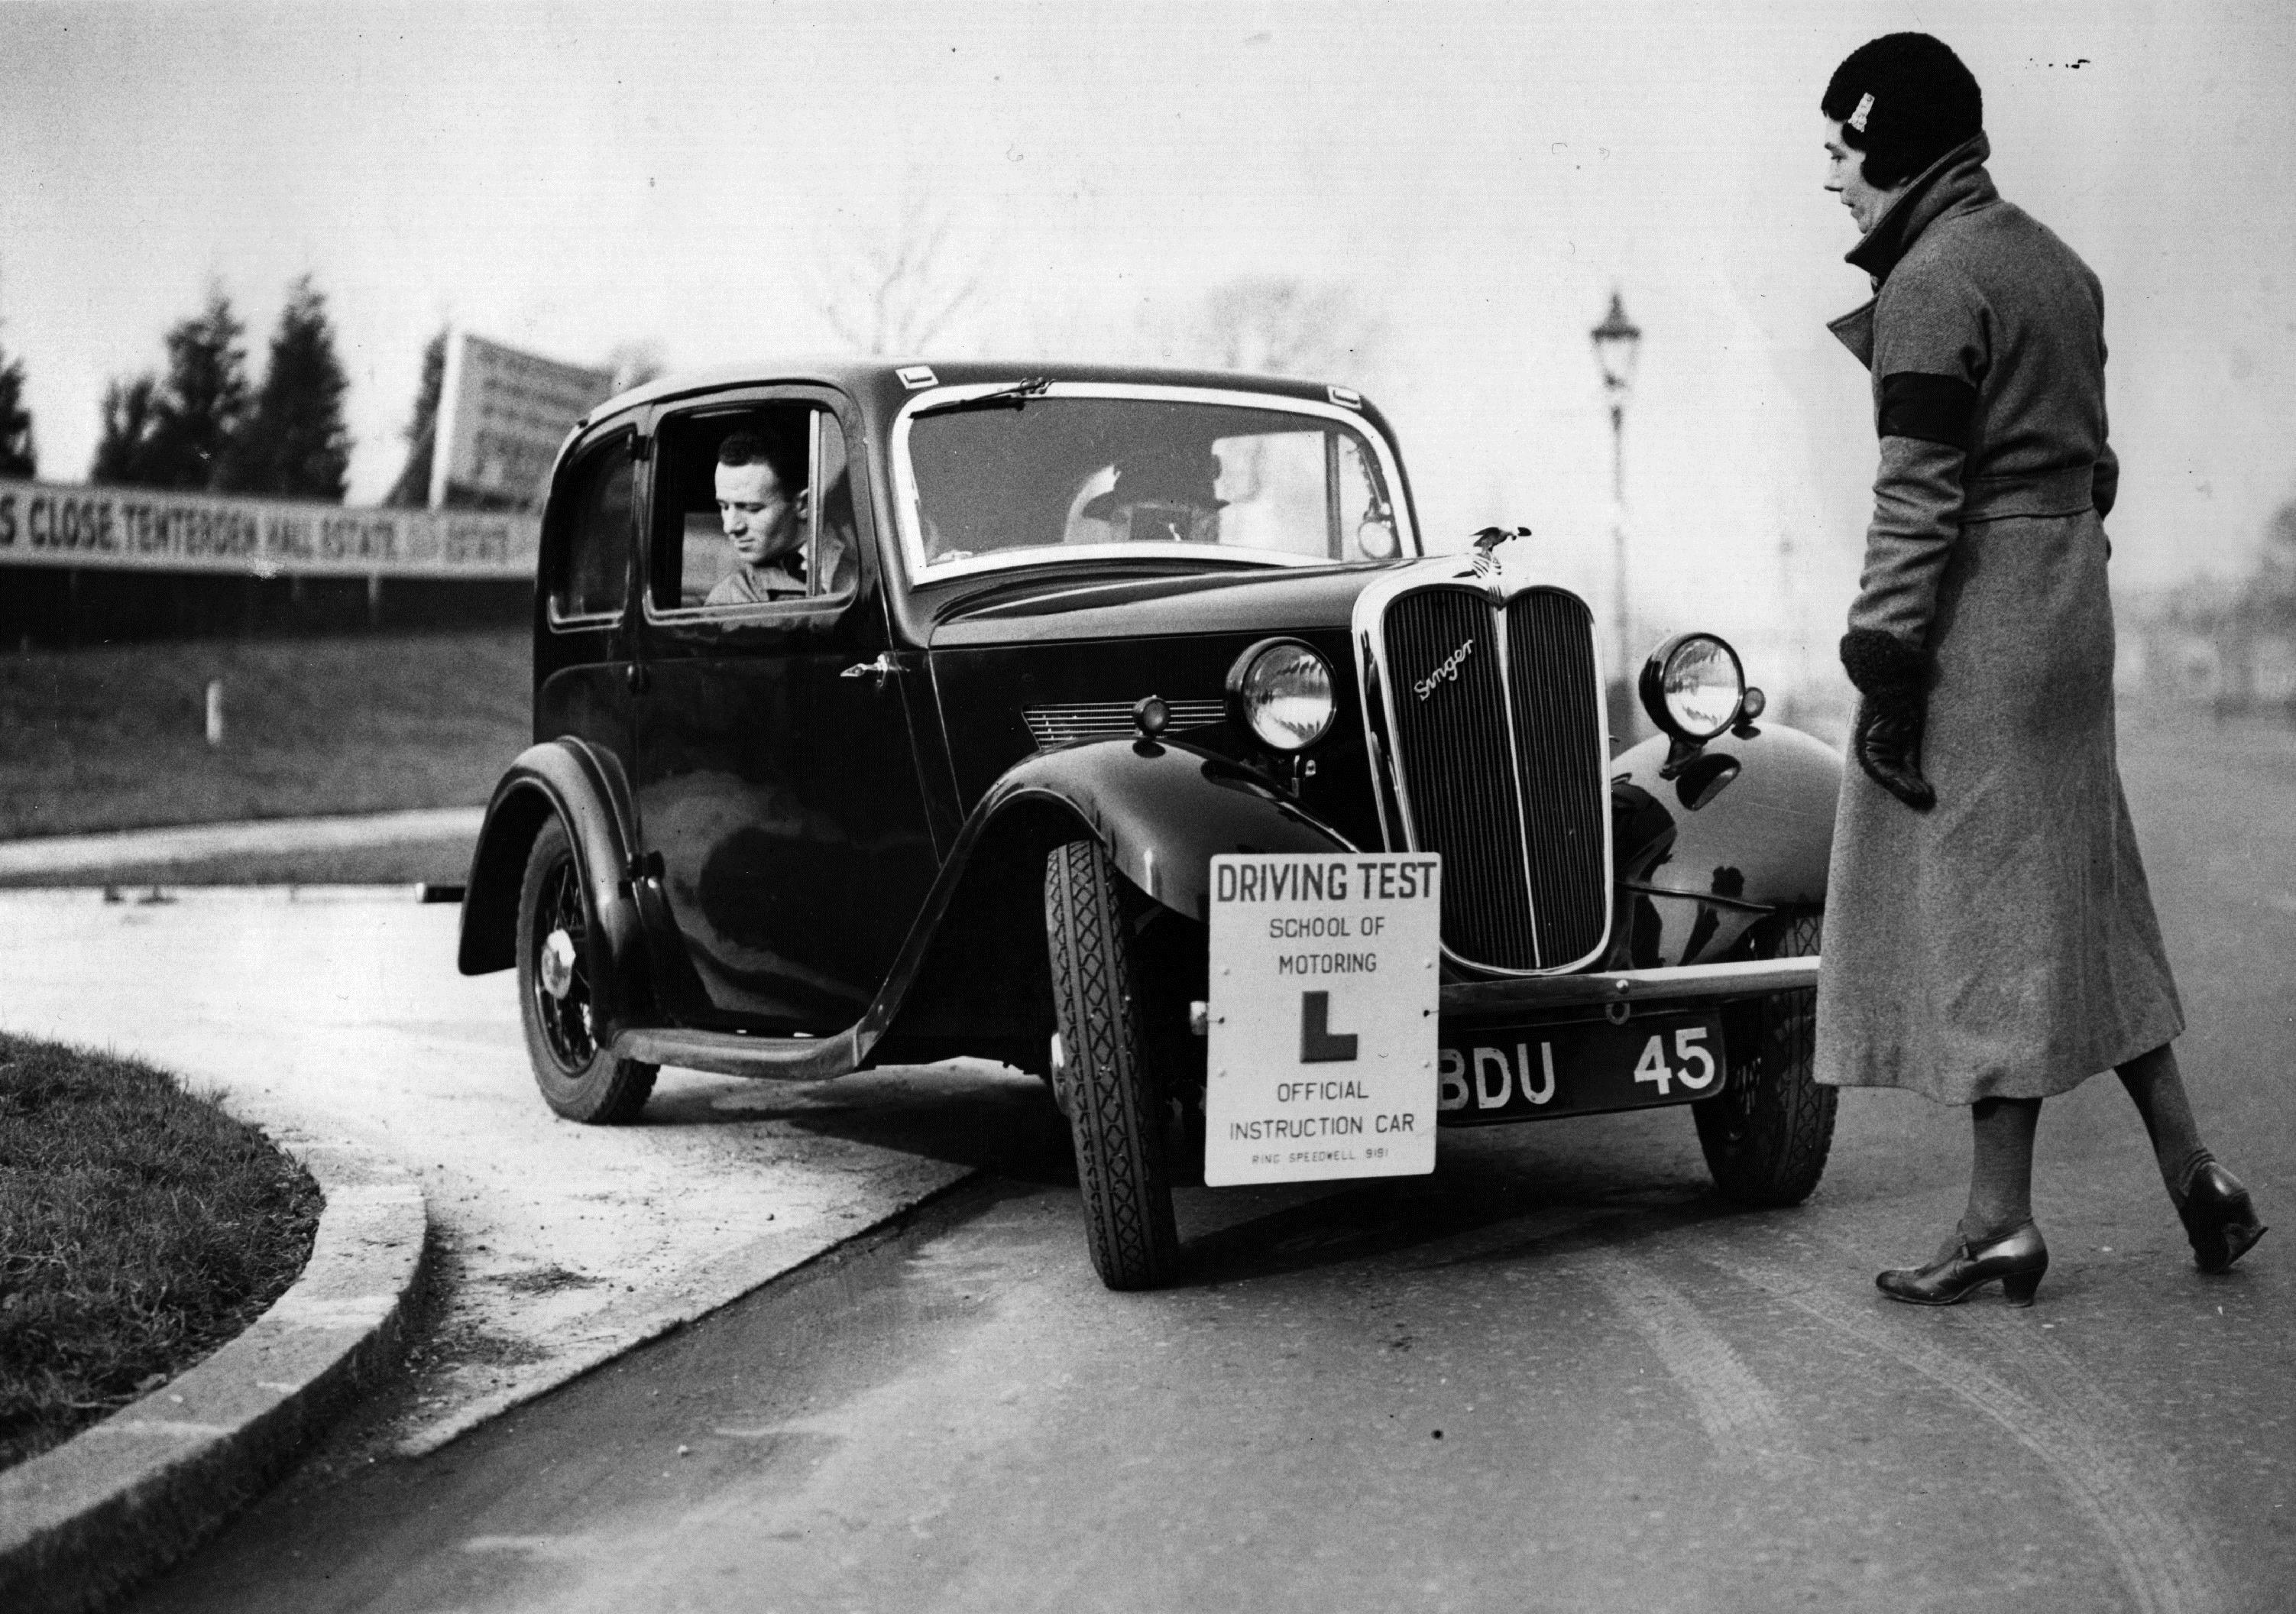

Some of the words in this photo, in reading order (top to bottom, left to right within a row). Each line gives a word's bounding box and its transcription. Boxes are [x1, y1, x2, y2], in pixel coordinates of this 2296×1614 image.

[29, 497, 114, 551] CLOSE
[320, 517, 398, 559] ESTATE
[1414, 639, 1473, 702] Singer
[1219, 864, 1348, 903] DRIVING
[1358, 863, 1437, 900] TEST
[1271, 919, 1351, 938] SCHOOL
[1362, 918, 1384, 936] OF
[1281, 954, 1377, 975] MOTORING
[1300, 991, 1358, 1065] L
[1438, 1042, 1556, 1111] BDU
[1633, 1027, 1715, 1095] 45
[1279, 1082, 1369, 1103] OFFICIAL
[1230, 1117, 1364, 1141] INSTRUCTION
[1377, 1114, 1414, 1133] CAR
[1288, 1150, 1356, 1163] SPEEDWELL
